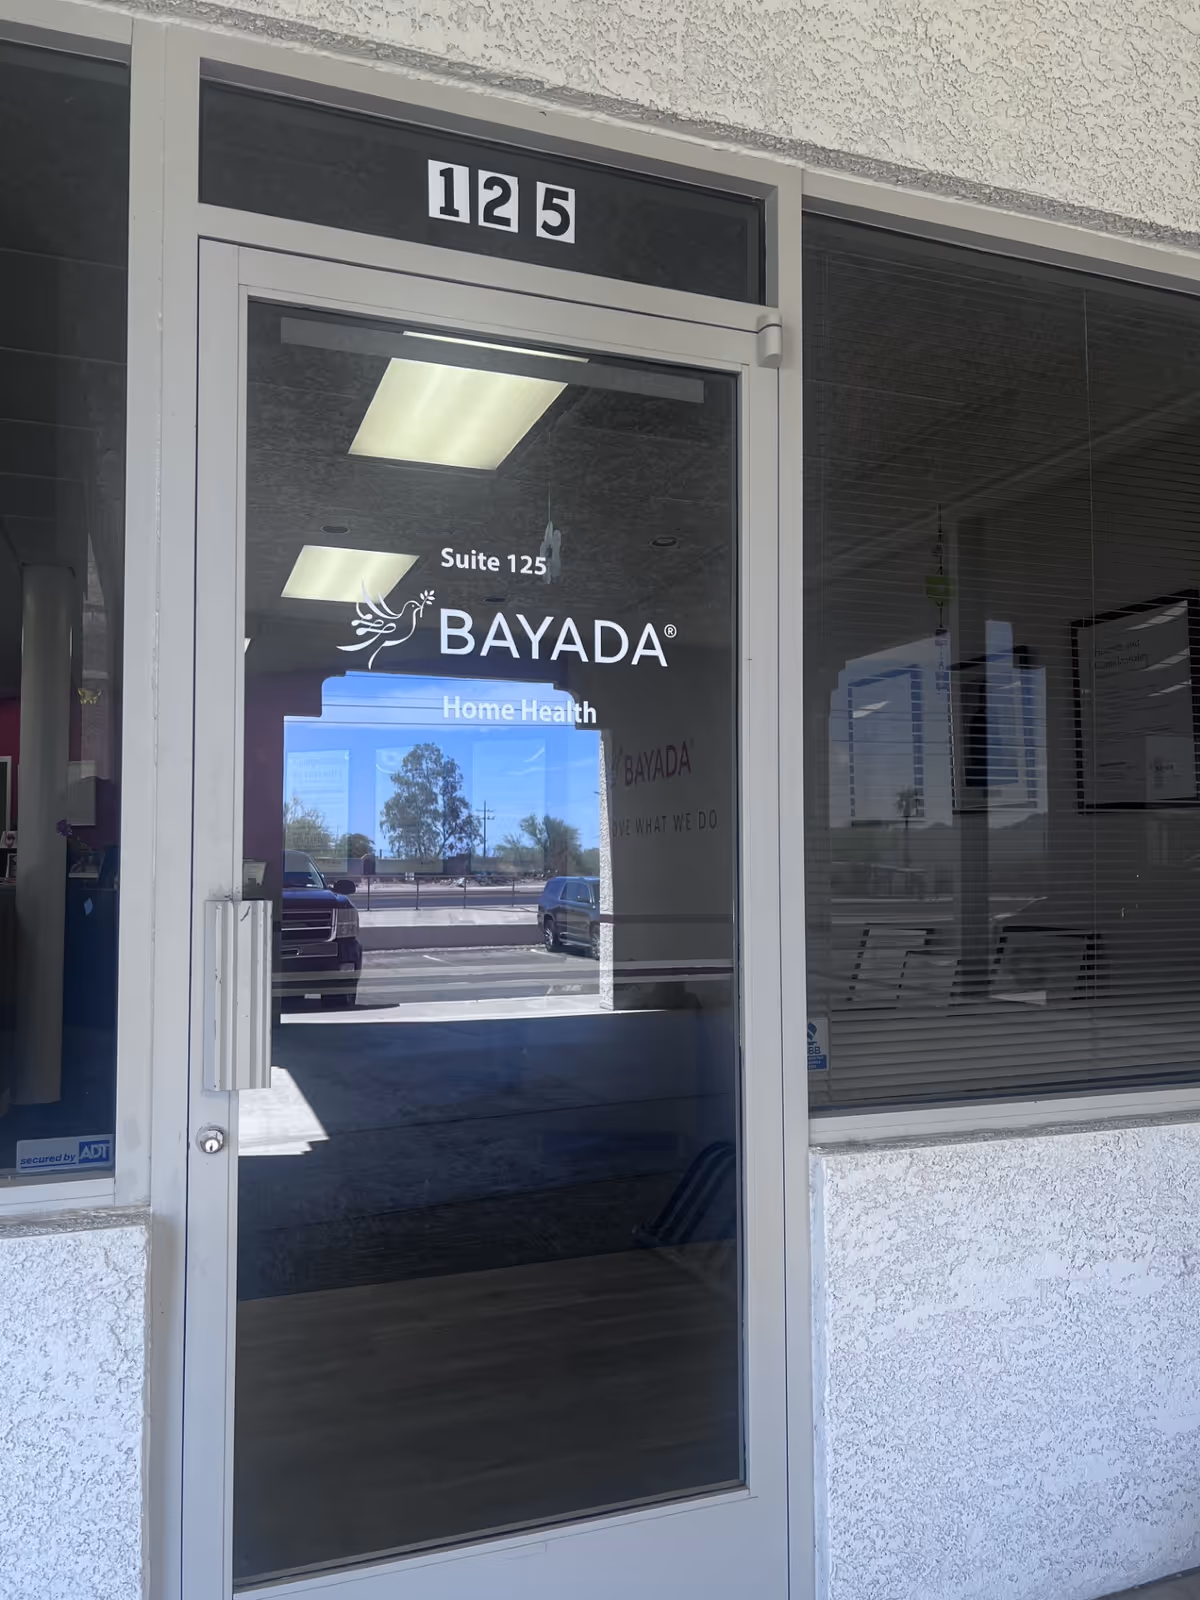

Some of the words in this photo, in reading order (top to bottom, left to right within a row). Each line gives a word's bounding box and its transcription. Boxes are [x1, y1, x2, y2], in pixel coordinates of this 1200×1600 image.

[439, 166, 571, 237] 125
[441, 547, 501, 572] Suite
[507, 553, 547, 576] 125
[443, 695, 515, 721] Home
[521, 699, 597, 724] Health
[635, 814, 667, 836] WHAT
[673, 812, 692, 833] WE
[698, 808, 718, 830] DO
[20, 1153, 62, 1165] secured
[63, 1152, 76, 1163] by
[80, 1144, 110, 1160] ADT
